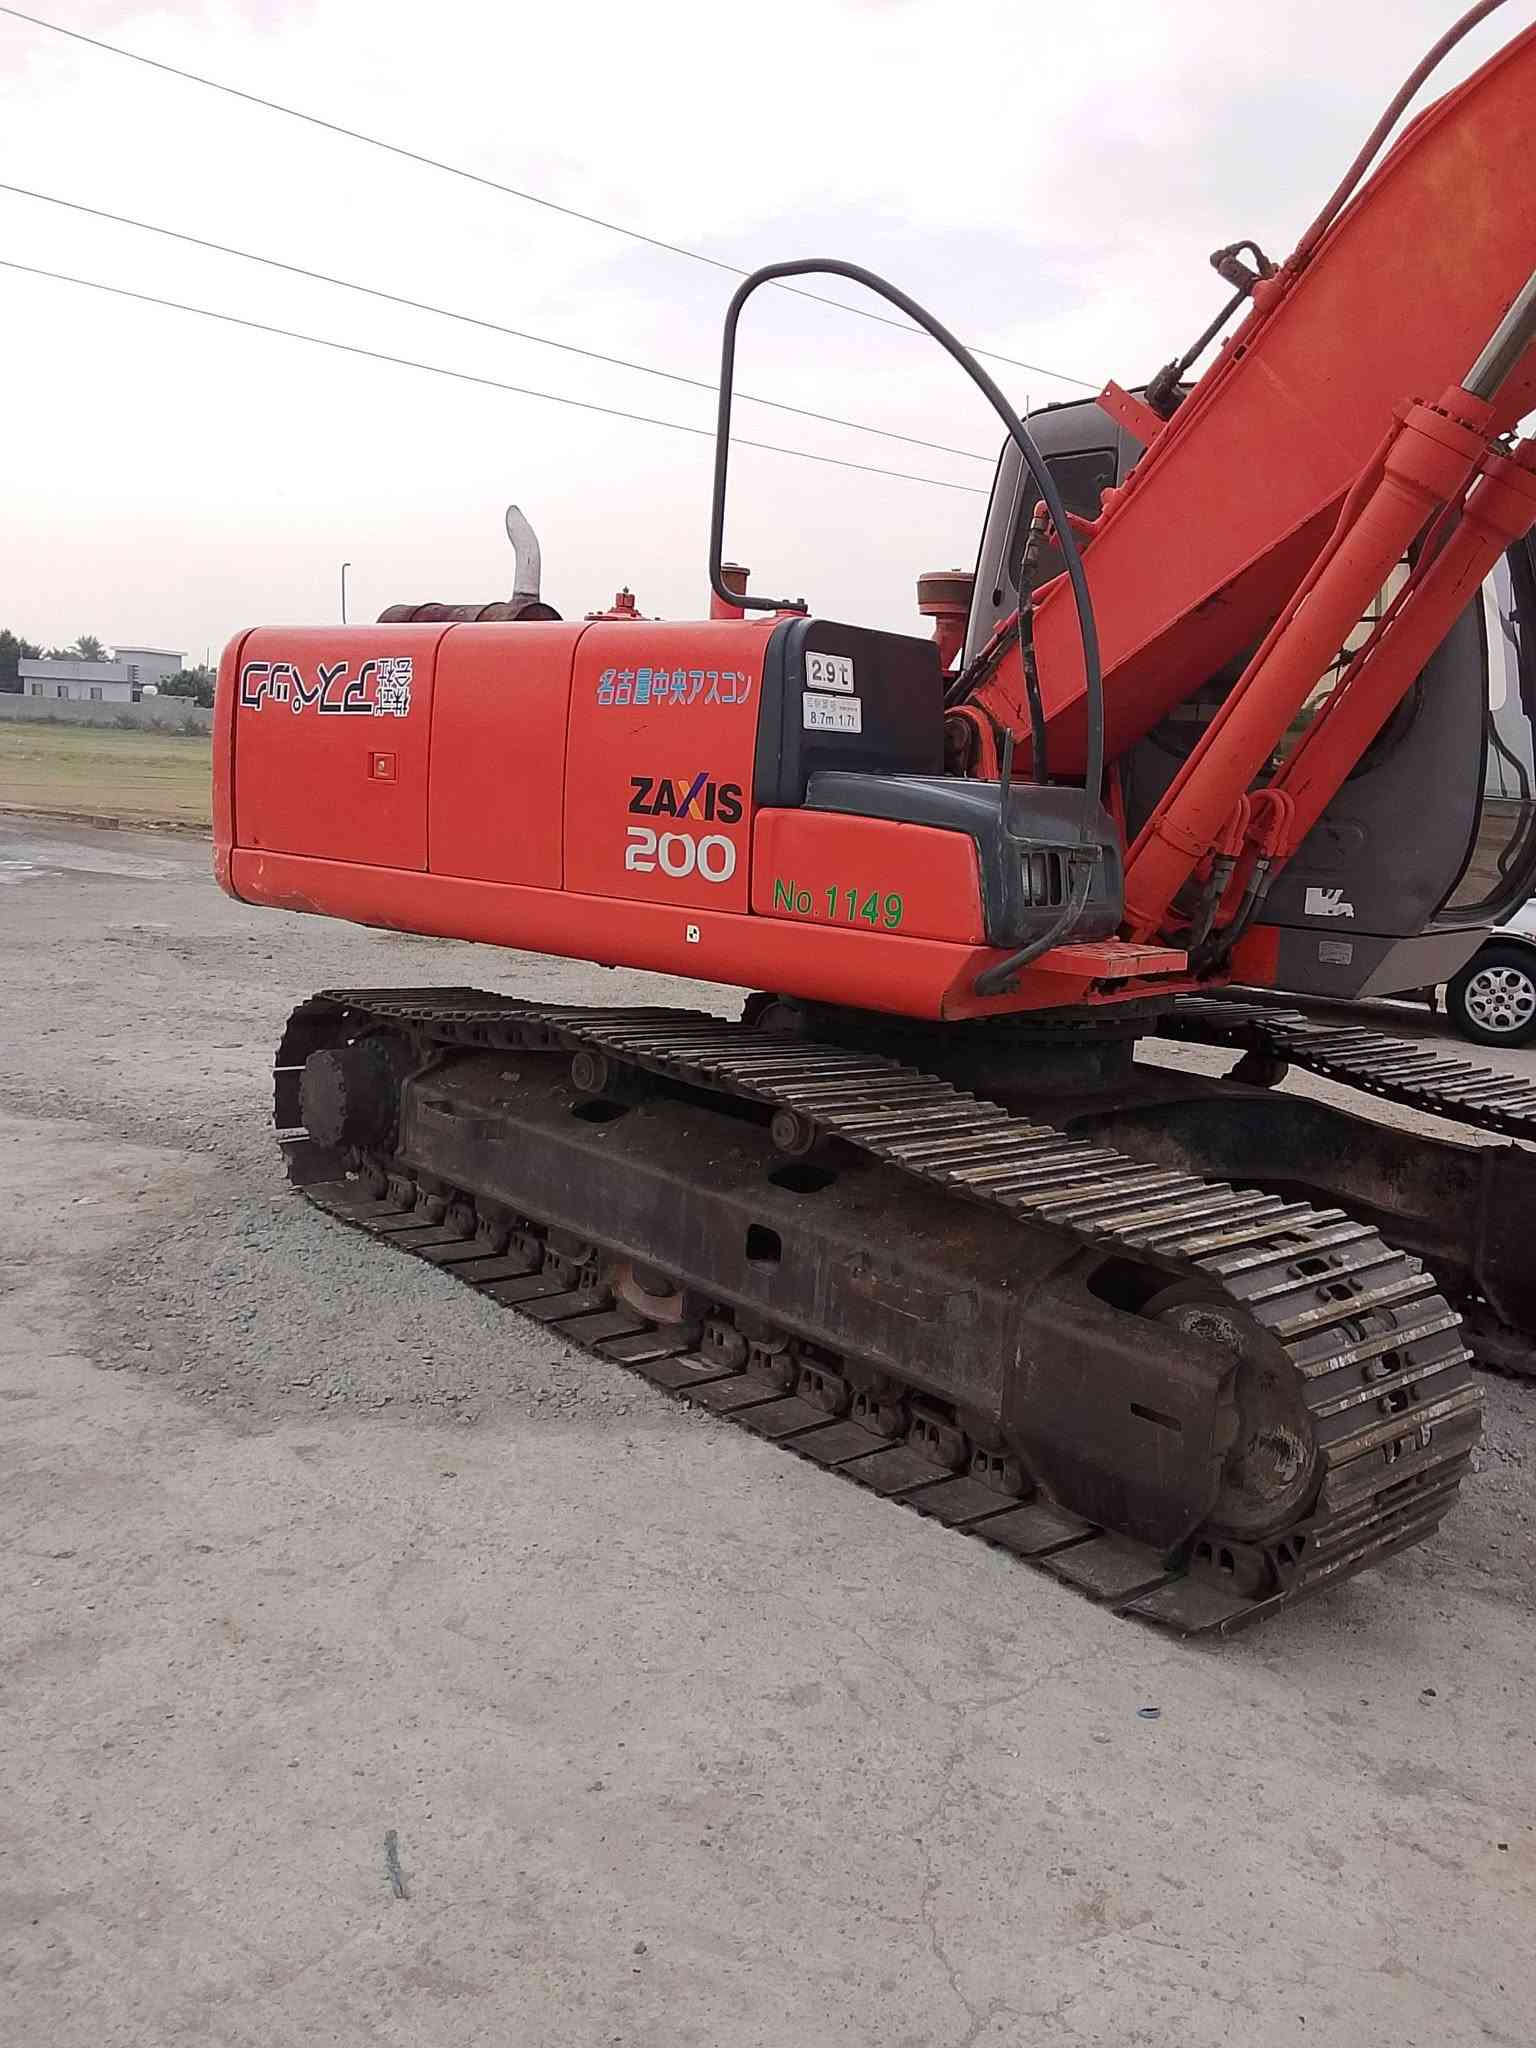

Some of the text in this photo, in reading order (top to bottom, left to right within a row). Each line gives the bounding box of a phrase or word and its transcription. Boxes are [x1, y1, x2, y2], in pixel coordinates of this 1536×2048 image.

[597, 667, 752, 705] 名古屋中央アスコン
[628, 771, 743, 824] ZAXIS
[625, 826, 736, 882] 200
